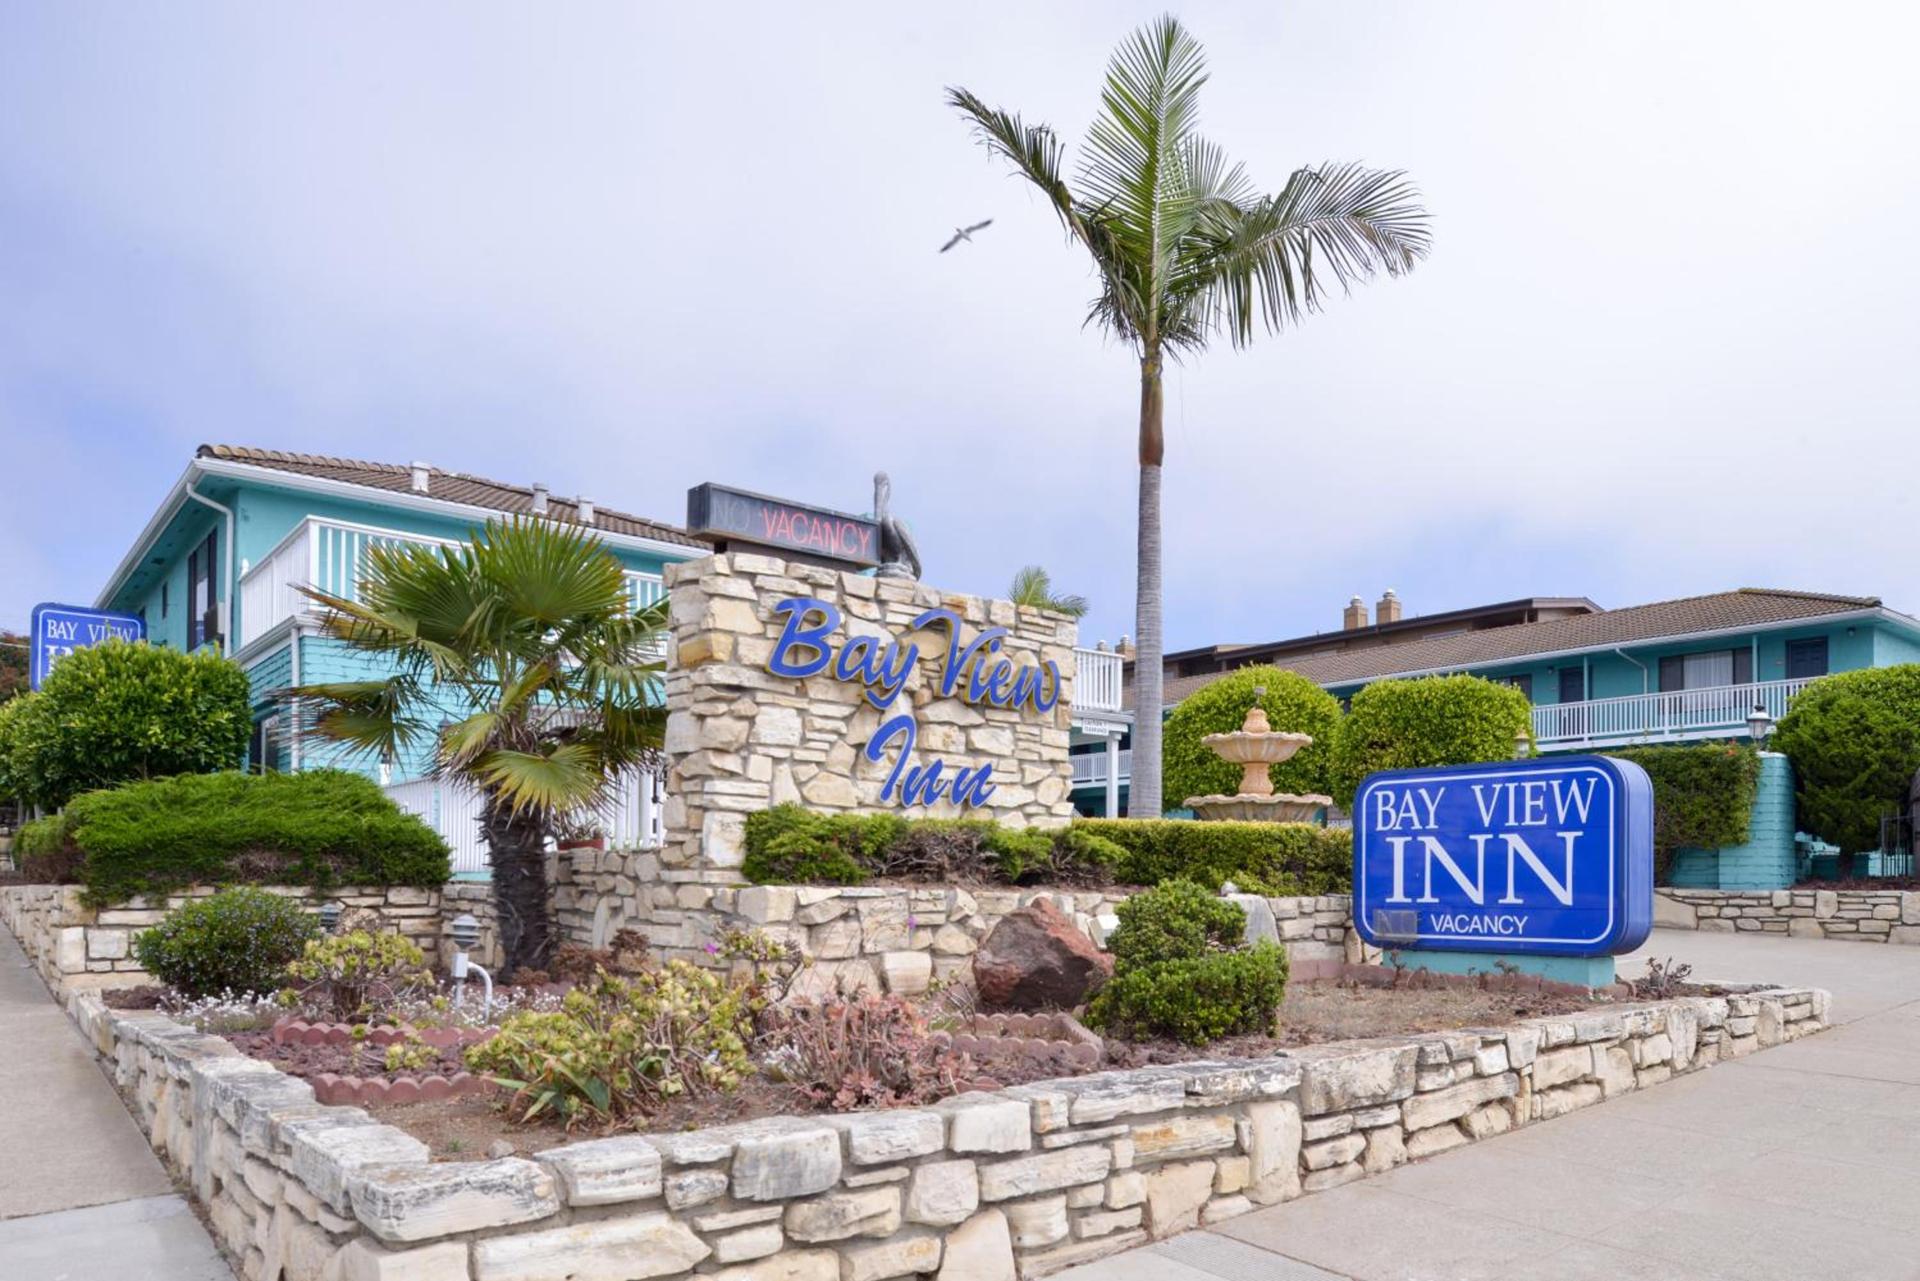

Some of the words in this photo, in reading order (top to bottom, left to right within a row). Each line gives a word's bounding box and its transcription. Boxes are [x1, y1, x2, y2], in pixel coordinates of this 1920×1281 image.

[762, 507, 871, 555] VACANCY
[47, 619, 78, 640] BAY
[767, 597, 919, 710] Bay
[911, 608, 1061, 713] View
[864, 714, 998, 809] Inn
[1374, 787, 1445, 831] BAY
[1471, 778, 1598, 827] VIEW
[1385, 831, 1584, 906] INN
[1430, 914, 1529, 935] VACANCY
